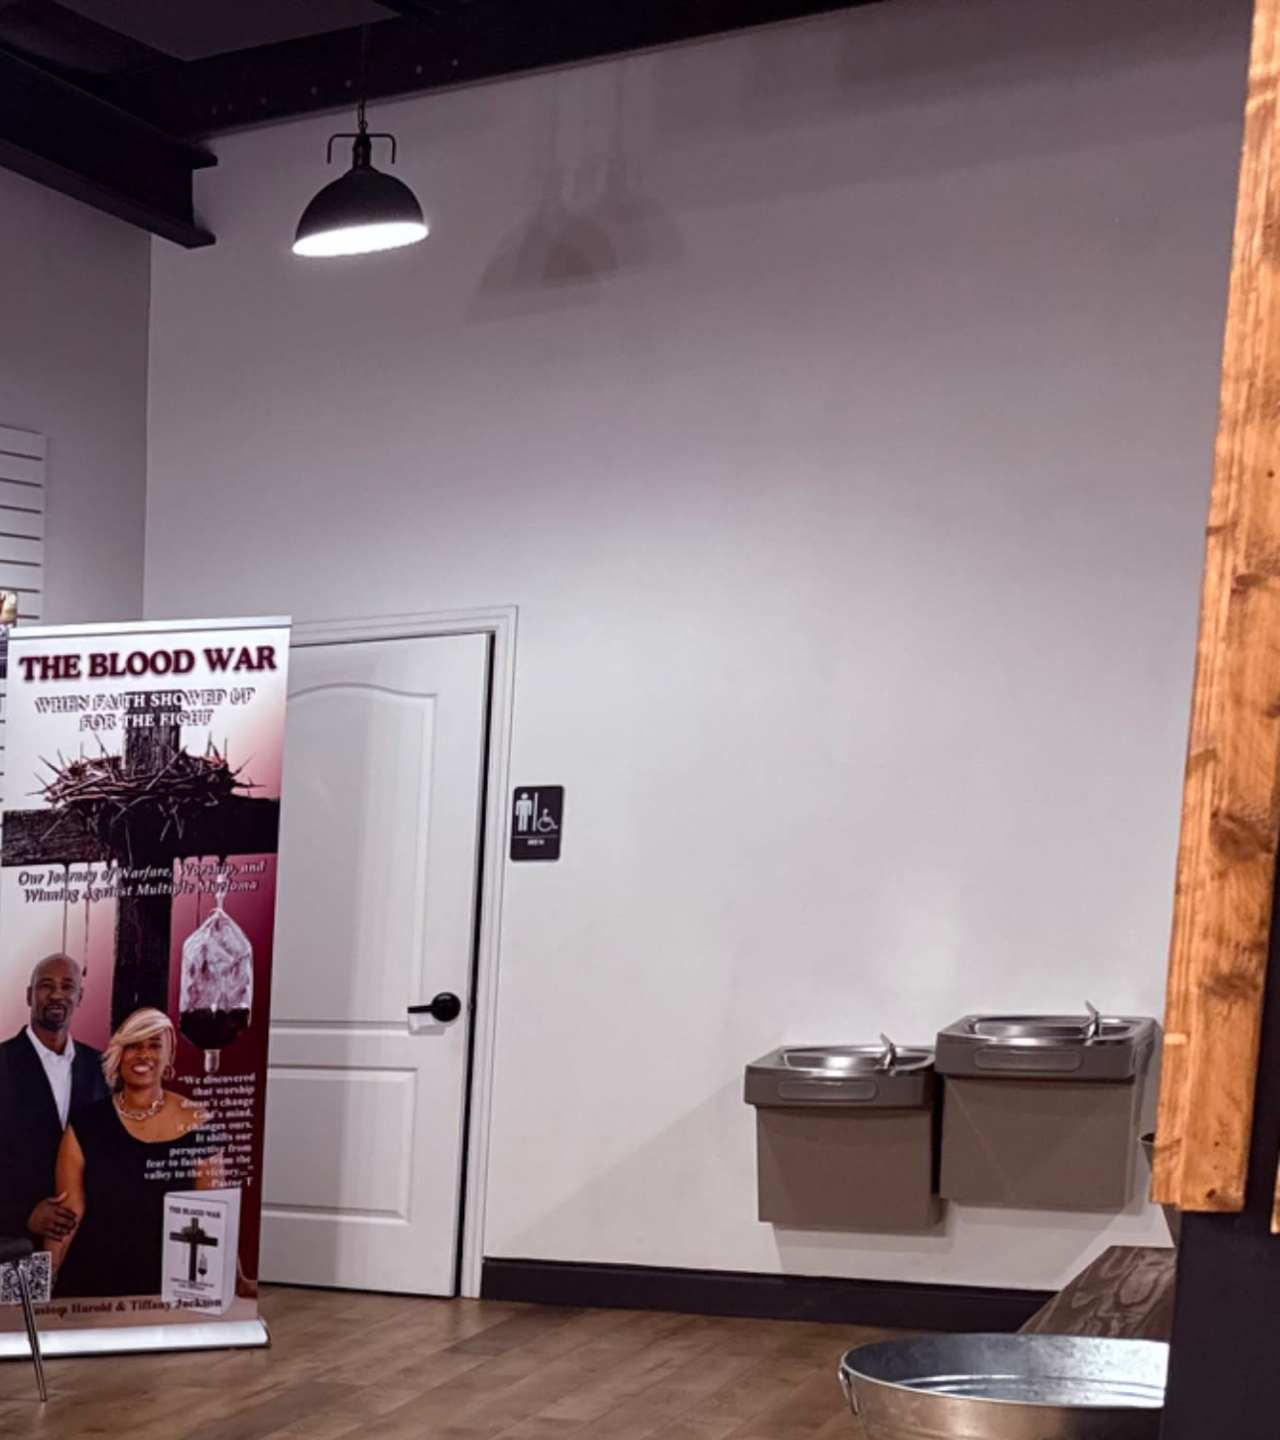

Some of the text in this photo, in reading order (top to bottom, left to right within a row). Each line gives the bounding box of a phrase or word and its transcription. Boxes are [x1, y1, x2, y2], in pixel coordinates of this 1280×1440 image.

[18, 645, 277, 682] THE BLOOD WAR
[34, 696, 92, 714] WHEN
[92, 693, 148, 712] FAITH
[149, 689, 228, 708] SHOWED
[79, 709, 215, 731] FOR THE FIGHT
[18, 870, 45, 886] Our
[115, 1300, 126, 1313] &
